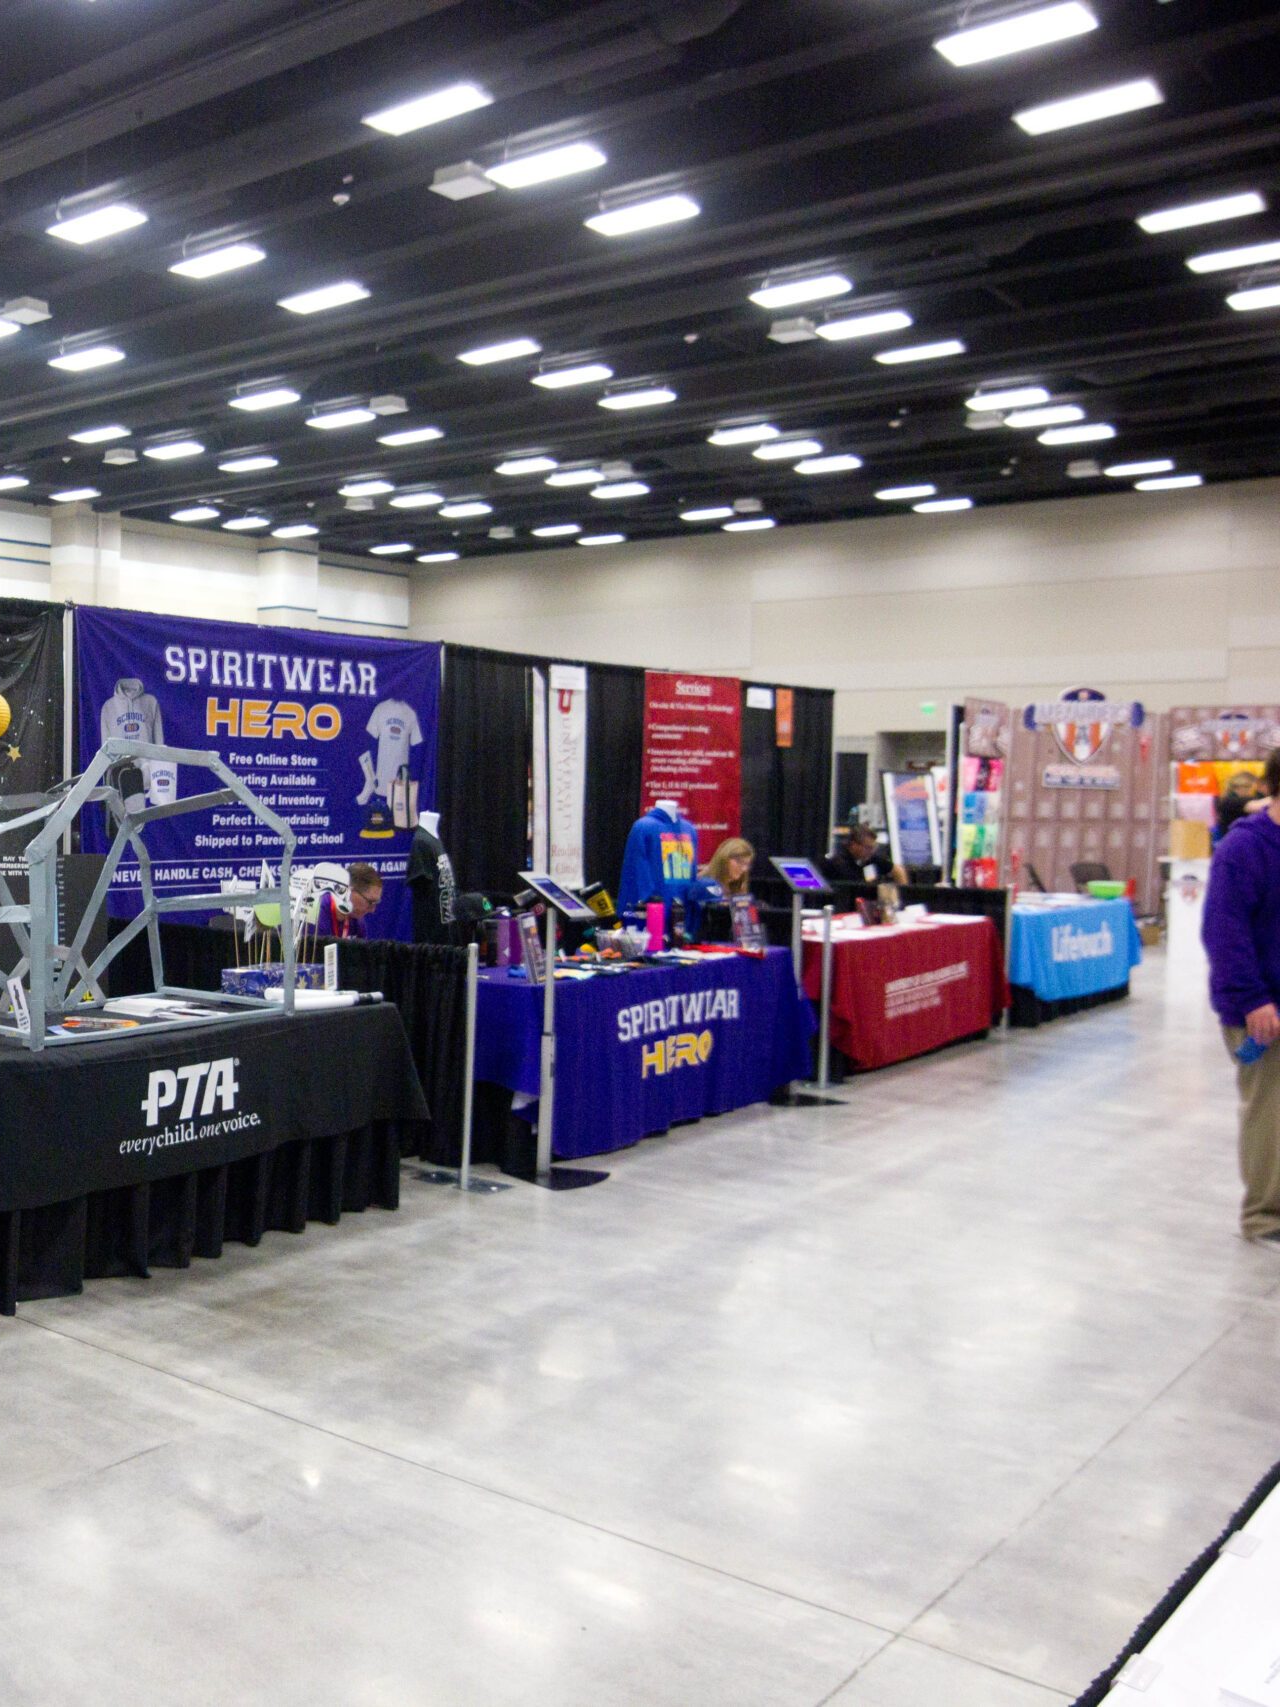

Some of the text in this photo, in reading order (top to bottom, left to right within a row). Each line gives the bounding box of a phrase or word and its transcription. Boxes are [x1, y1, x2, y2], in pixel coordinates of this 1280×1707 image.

[164, 646, 377, 695] SPIRITWEAR
[206, 697, 342, 741] HERO
[229, 752, 318, 766] Free Online Store
[237, 773, 316, 787] orting Available
[278, 795, 325, 807] Inventory
[212, 814, 252, 826] Perfect
[254, 814, 265, 826] fo
[194, 834, 239, 848] Shipped
[241, 835, 252, 846] to
[297, 835, 308, 845] or
[310, 833, 344, 844] School
[112, 870, 143, 883] NEVE
[154, 868, 199, 880] HANDLE
[202, 867, 236, 880] CASH,
[239, 865, 282, 878] CHEKS
[641, 1029, 713, 1080] HERO
[141, 1057, 239, 1127] PTA
